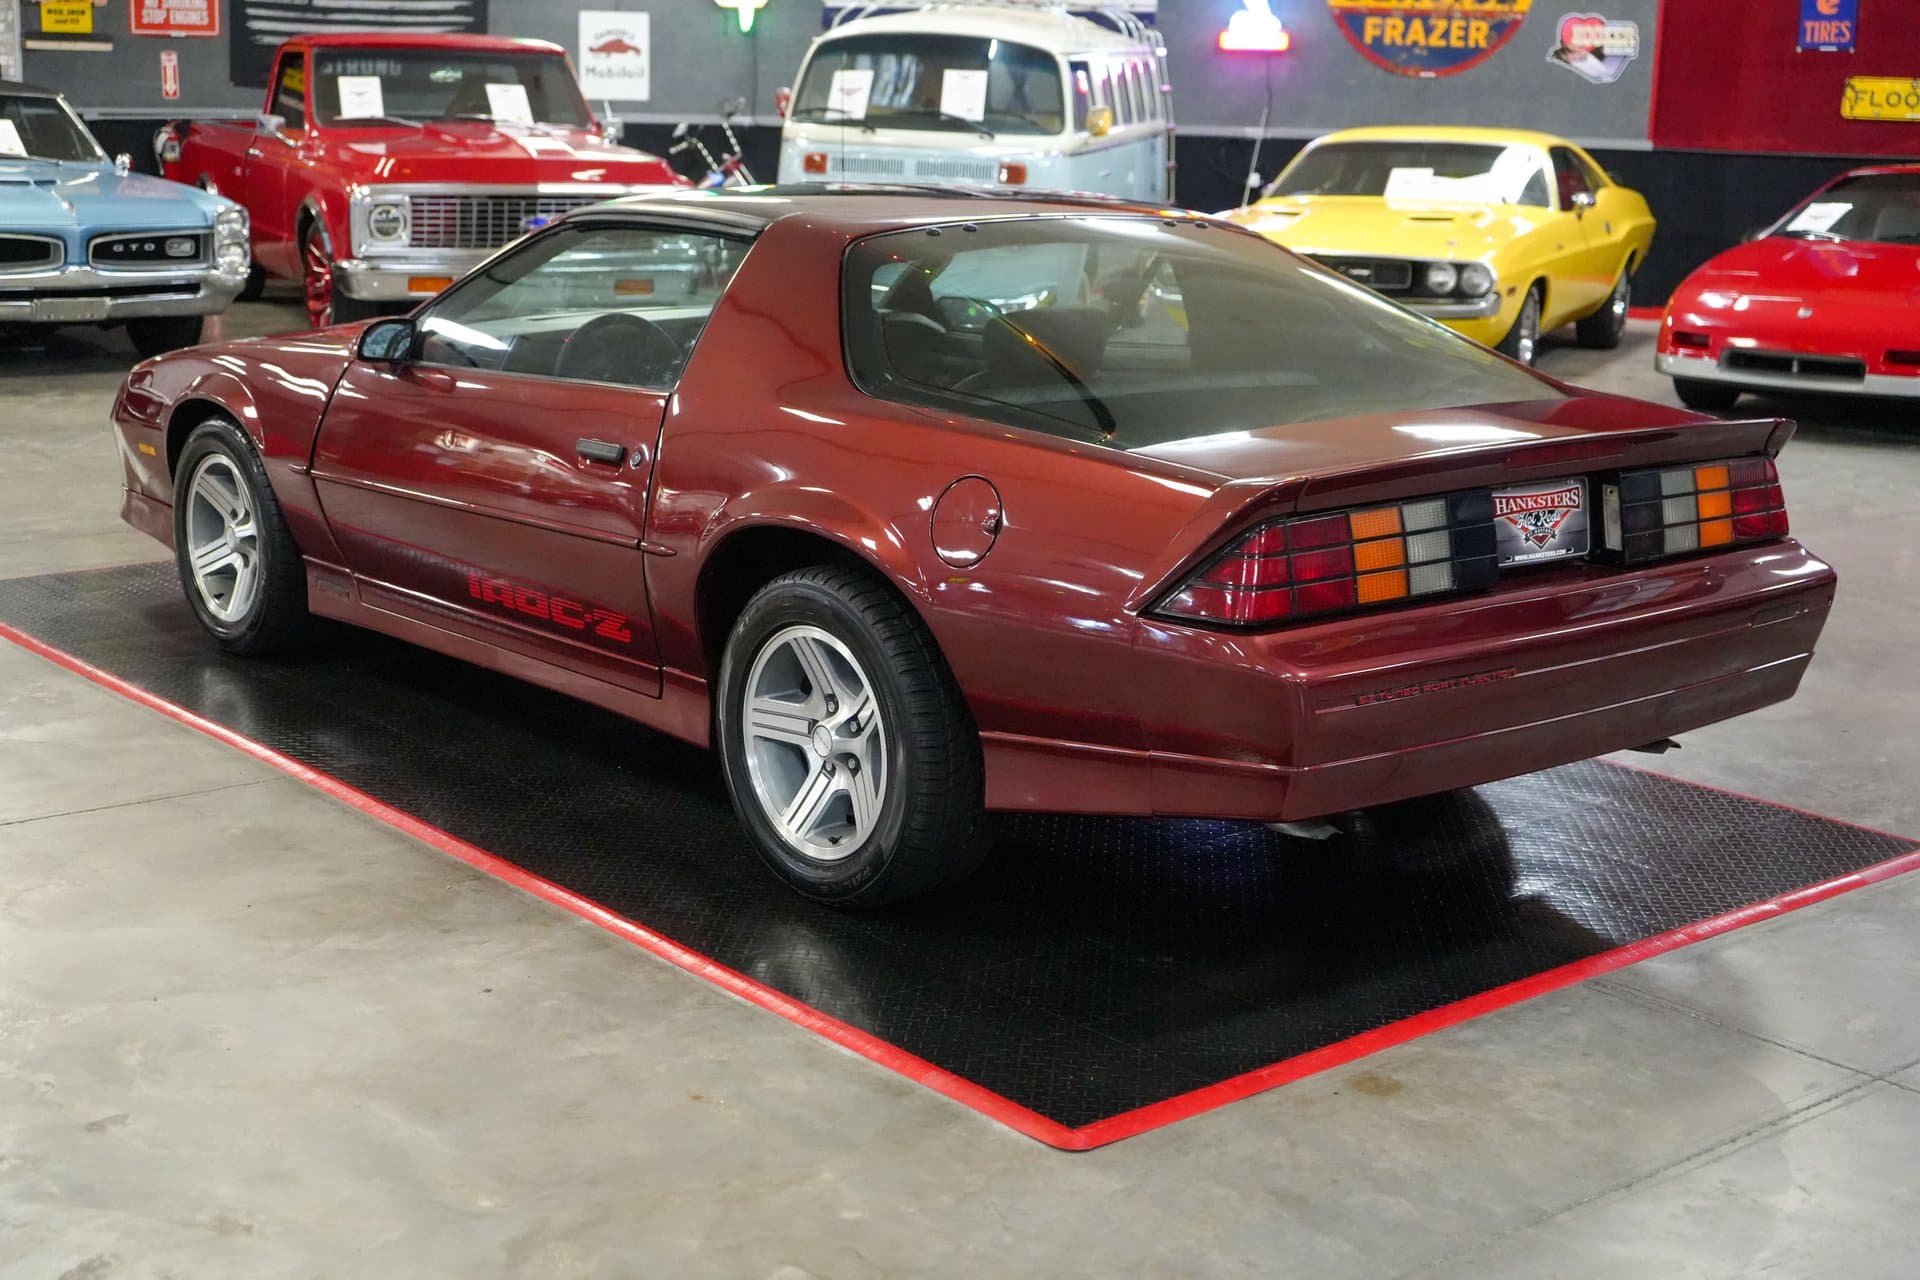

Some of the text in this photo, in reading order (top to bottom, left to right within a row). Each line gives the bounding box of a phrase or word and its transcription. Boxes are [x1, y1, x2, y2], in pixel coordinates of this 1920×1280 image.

[142, 8, 209, 26] STOP ENGINES
[1363, 16, 1489, 48] FRAZER
[1804, 21, 1851, 43] TIRES
[584, 65, 645, 79] Mobiloil
[112, 242, 156, 253] GTO
[1494, 489, 1580, 516] HANKSTERS
[1517, 511, 1537, 529] Hot
[467, 573, 632, 644] IROC-Z
